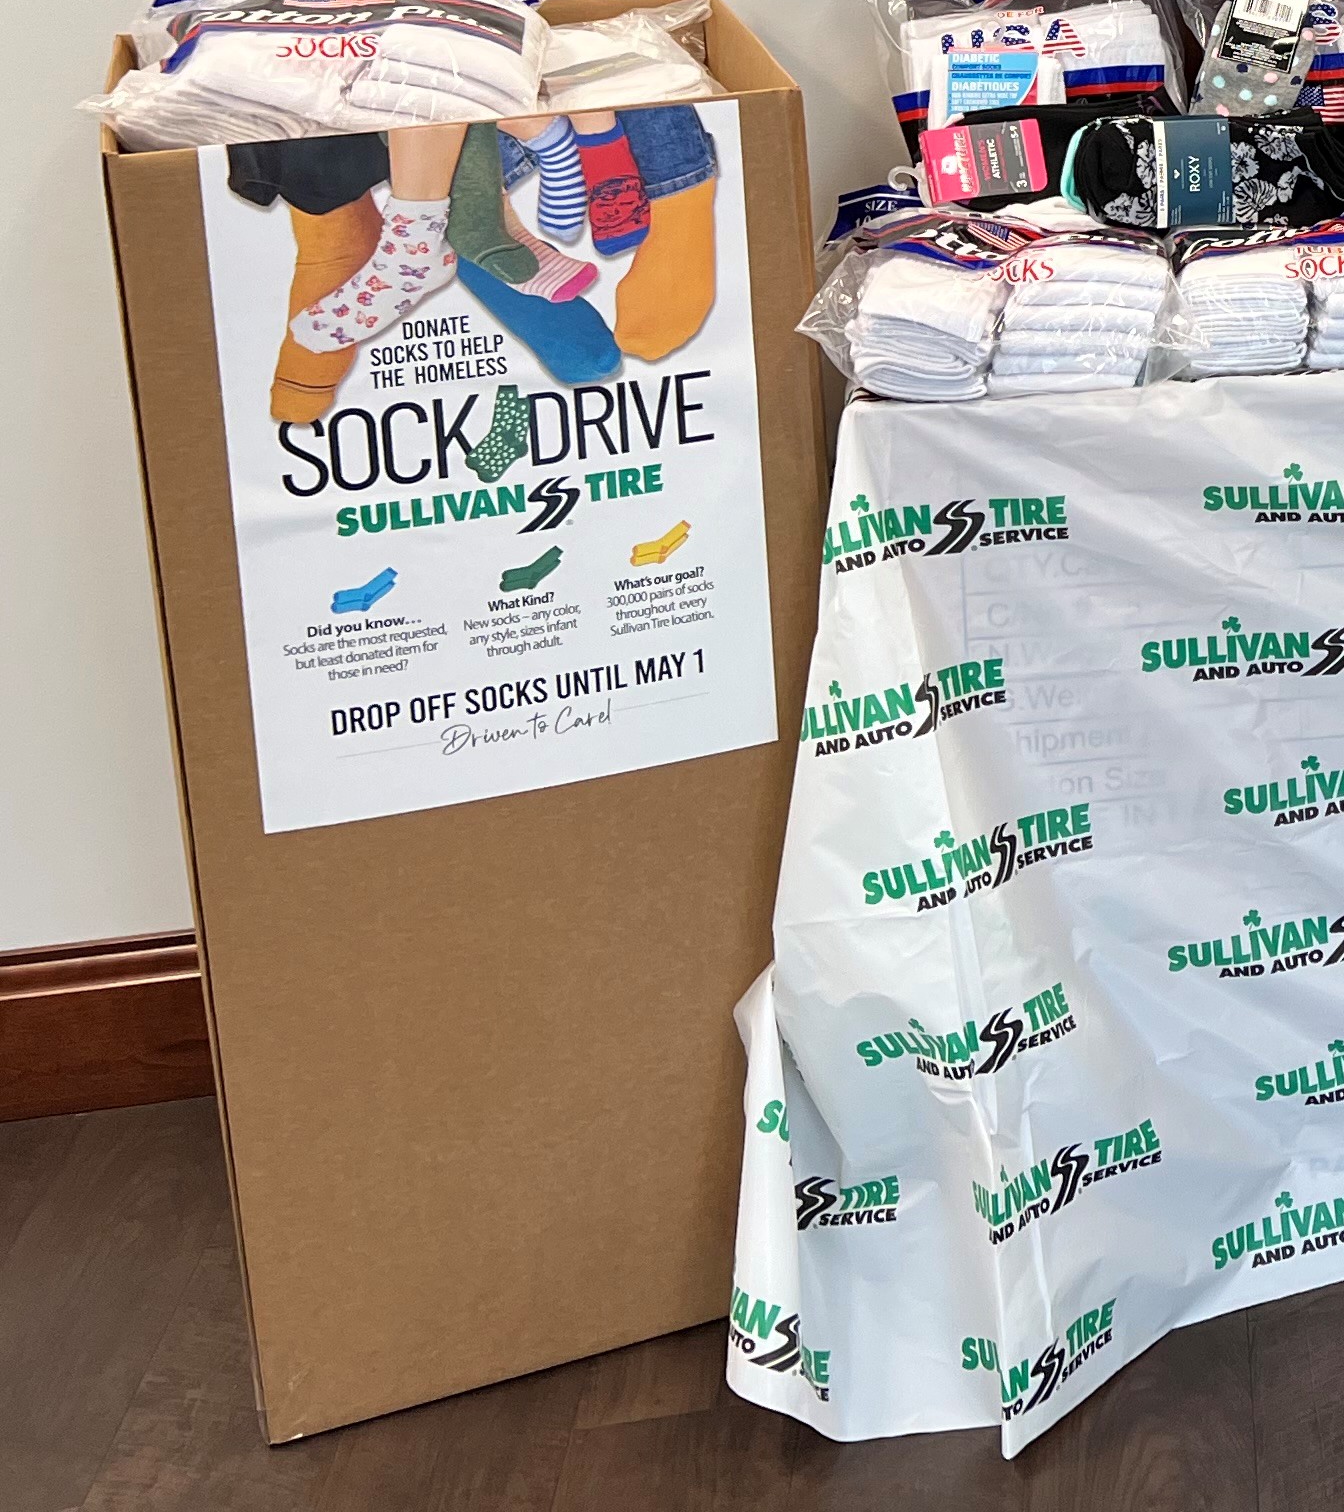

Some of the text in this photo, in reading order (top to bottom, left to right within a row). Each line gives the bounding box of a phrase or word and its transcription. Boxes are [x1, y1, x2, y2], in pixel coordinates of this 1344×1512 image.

[952, 53, 1000, 63] DIABETIC
[990, 138, 1003, 180] ATHLETIC
[1188, 154, 1201, 193] ROXY
[865, 199, 898, 212] SIZE
[402, 315, 469, 340] DONATE
[370, 335, 504, 366] SOCKS TO HELP
[370, 357, 507, 390] THE HOMELESS
[278, 370, 715, 497] SOCK DRIVE
[336, 464, 664, 537] SULLIVAN TIRE
[1254, 511, 1301, 523] AND
[614, 566, 705, 591] What's our goal?
[488, 591, 554, 612] What Kind?
[606, 580, 715, 608] 300,000 pairs of socks
[463, 604, 582, 631] New socks any color,
[616, 597, 708, 621] throughout every
[307, 624, 332, 638] Did
[335, 622, 362, 637] you
[469, 619, 578, 646] any style, sizes infant
[610, 611, 715, 637] Sullivan Tire location.
[283, 624, 448, 657] Socks are the most requested,
[487, 636, 563, 658] through adult.
[296, 641, 439, 670] but least donated item for
[328, 659, 409, 681] those in need?
[331, 648, 706, 736] DROP OFF SOCKS UNTIL MAY 1
[440, 724, 529, 756] Driven
[526, 712, 549, 739] to
[862, 802, 1092, 905] SULLIVAN TIRE
[1251, 1245, 1295, 1268] AND
